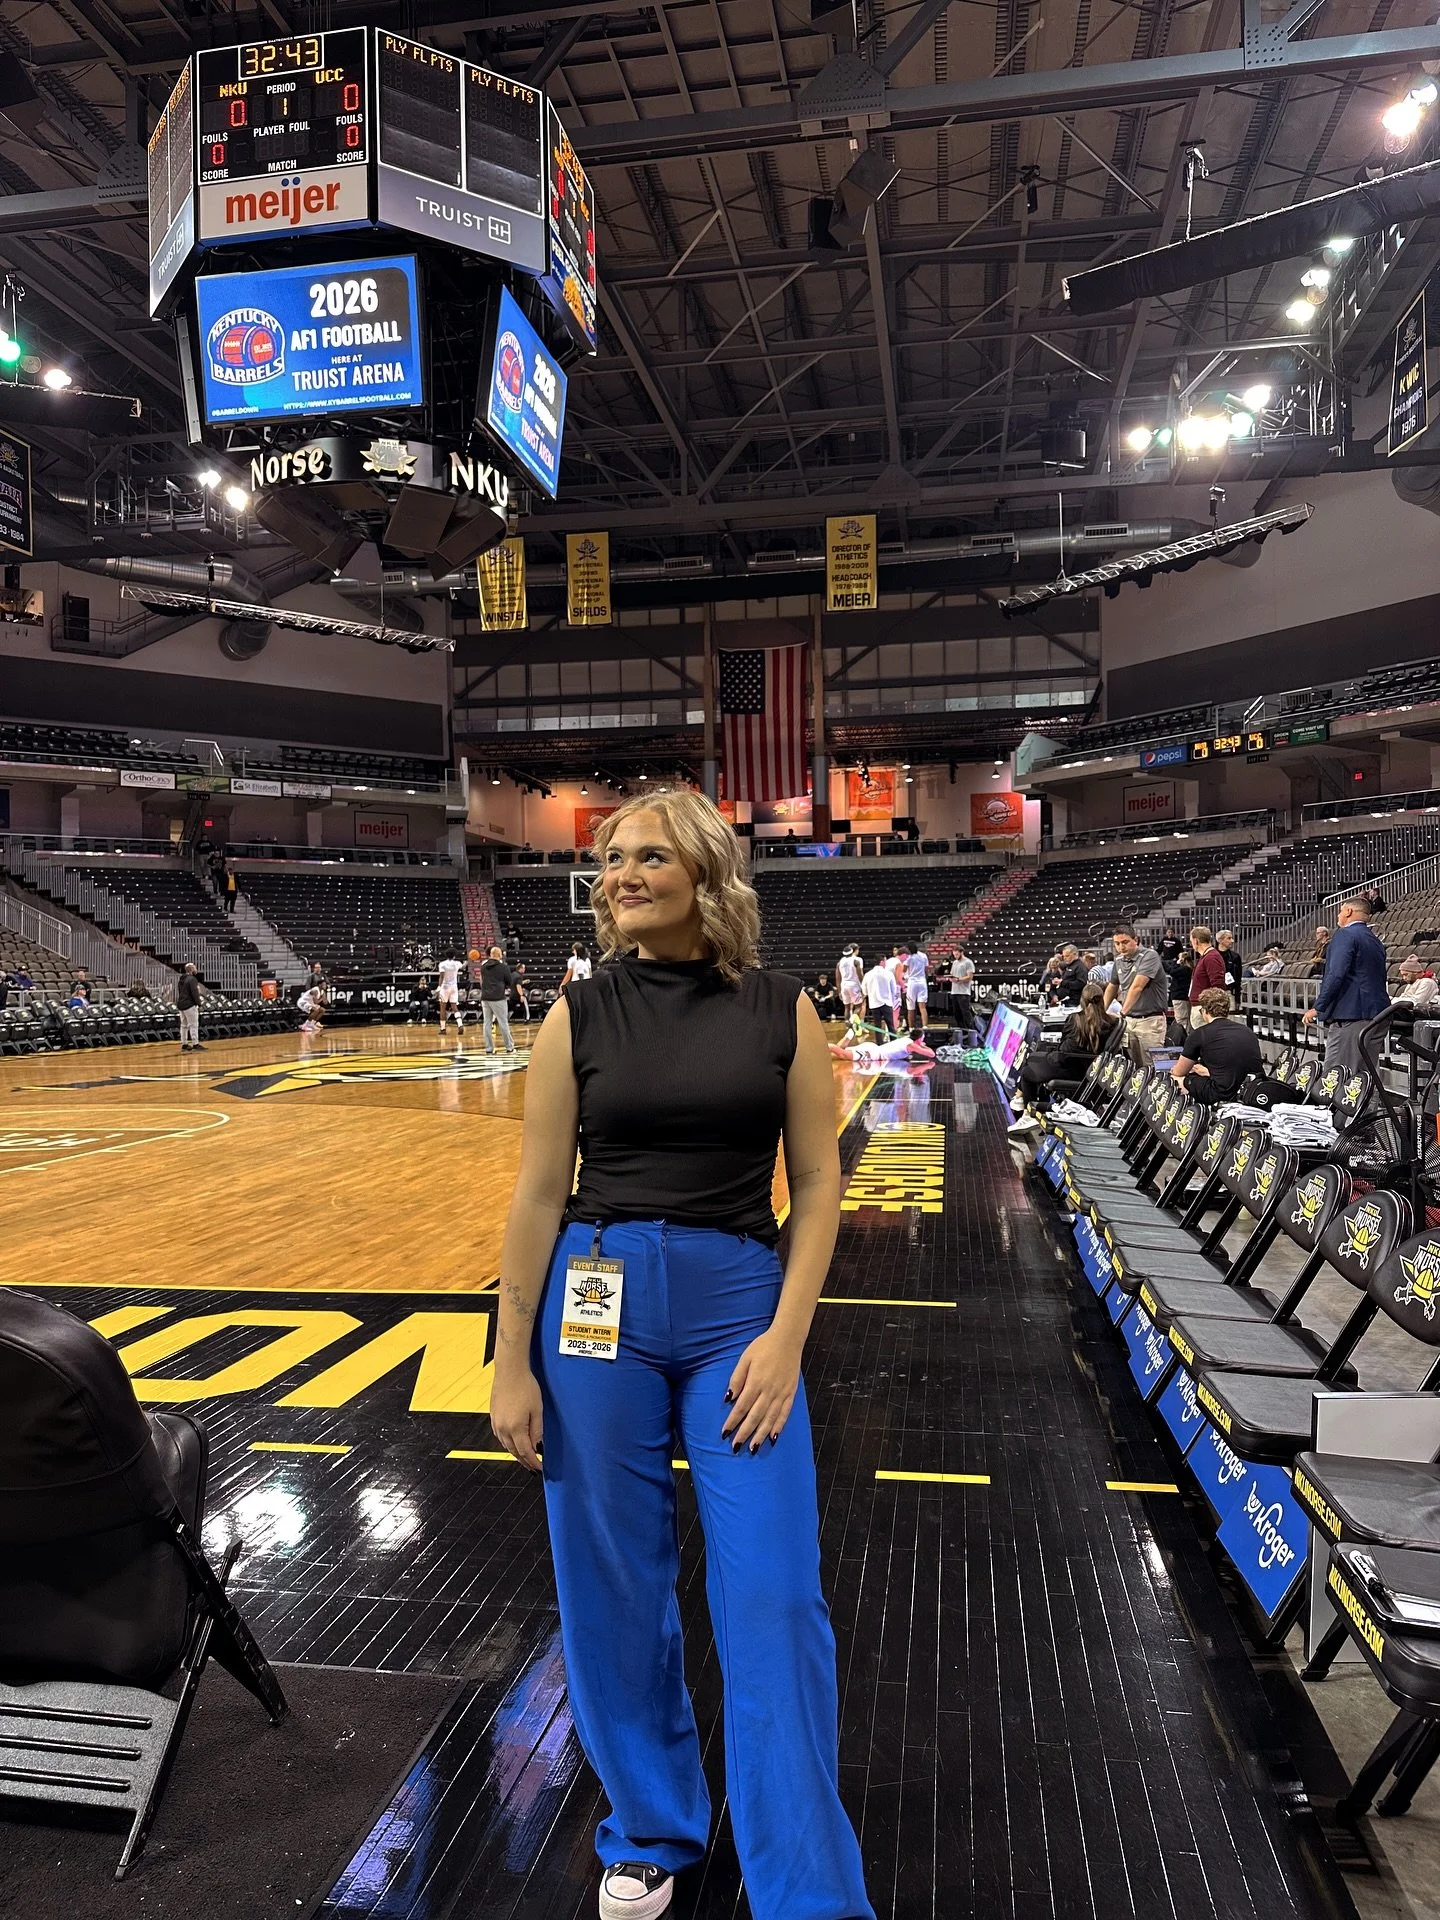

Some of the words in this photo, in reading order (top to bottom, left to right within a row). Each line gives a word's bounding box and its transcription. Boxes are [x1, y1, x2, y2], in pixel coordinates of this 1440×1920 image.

[246, 38, 319, 75] 32:43
[386, 36, 407, 55] PLY
[413, 47, 427, 64] FL
[430, 53, 453, 73] PTS
[315, 68, 344, 84] UCC
[471, 69, 492, 87] PLY
[497, 80, 510, 96] FL
[512, 85, 534, 104] PTS
[219, 82, 248, 97] NKU
[266, 82, 296, 94] PERIOD
[343, 83, 359, 111] 0
[230, 99, 246, 127] 0
[336, 113, 363, 126] FOULS
[202, 132, 228, 145] FOULS
[253, 124, 285, 138] PLAYER
[288, 120, 310, 133] FOUL
[346, 125, 359, 147] 0
[212, 144, 225, 165] 0
[336, 150, 364, 163] SCORE
[202, 168, 229, 181] SCORE
[267, 159, 297, 172] MATCH
[225, 176, 341, 226] meijer
[415, 196, 484, 231] TRUIST
[309, 277, 379, 318] 2026
[211, 310, 280, 342] KENTUCKY
[290, 328, 318, 352] AF1
[321, 320, 402, 348] FOOTBALL
[214, 356, 284, 383] BARRELS
[331, 355, 350, 365] HERE
[351, 354, 363, 363] AT
[291, 367, 348, 391] TRUIST
[352, 362, 405, 386] ARENA
[1399, 362, 1420, 396] KWIC
[1401, 414, 1417, 437] 1976
[250, 446, 325, 492] Norse
[449, 451, 508, 508] NKU
[835, 552, 868, 560] ATHLETICS
[862, 543, 871, 551] OF
[831, 574, 849, 582] HEAD
[849, 572, 872, 581] COACH
[833, 592, 871, 608] MEIER
[1215, 735, 1241, 750] 32:43
[1157, 751, 1182, 764] pepsi
[252, 783, 278, 792] Elizabeth
[1127, 793, 1170, 813] meijer
[359, 821, 403, 839] meijer
[361, 985, 412, 1007] meijer
[573, 1261, 595, 1272] EVENT
[596, 1263, 618, 1273] STAFF
[581, 1281, 607, 1293] NORSE
[580, 1309, 603, 1317] ATHLETICS
[568, 1325, 592, 1334] STUDENT
[592, 1328, 611, 1336] INTERN
[1147, 1334, 1165, 1375] Kroger
[1197, 1382, 1232, 1436] NKUNORSE.COM
[1216, 1438, 1248, 1485] Kroger
[1294, 1468, 1342, 1541] NKUNORSE.COM
[1252, 1502, 1296, 1570] Kroger
[1329, 1566, 1386, 1663] NKUNORSE.COM
